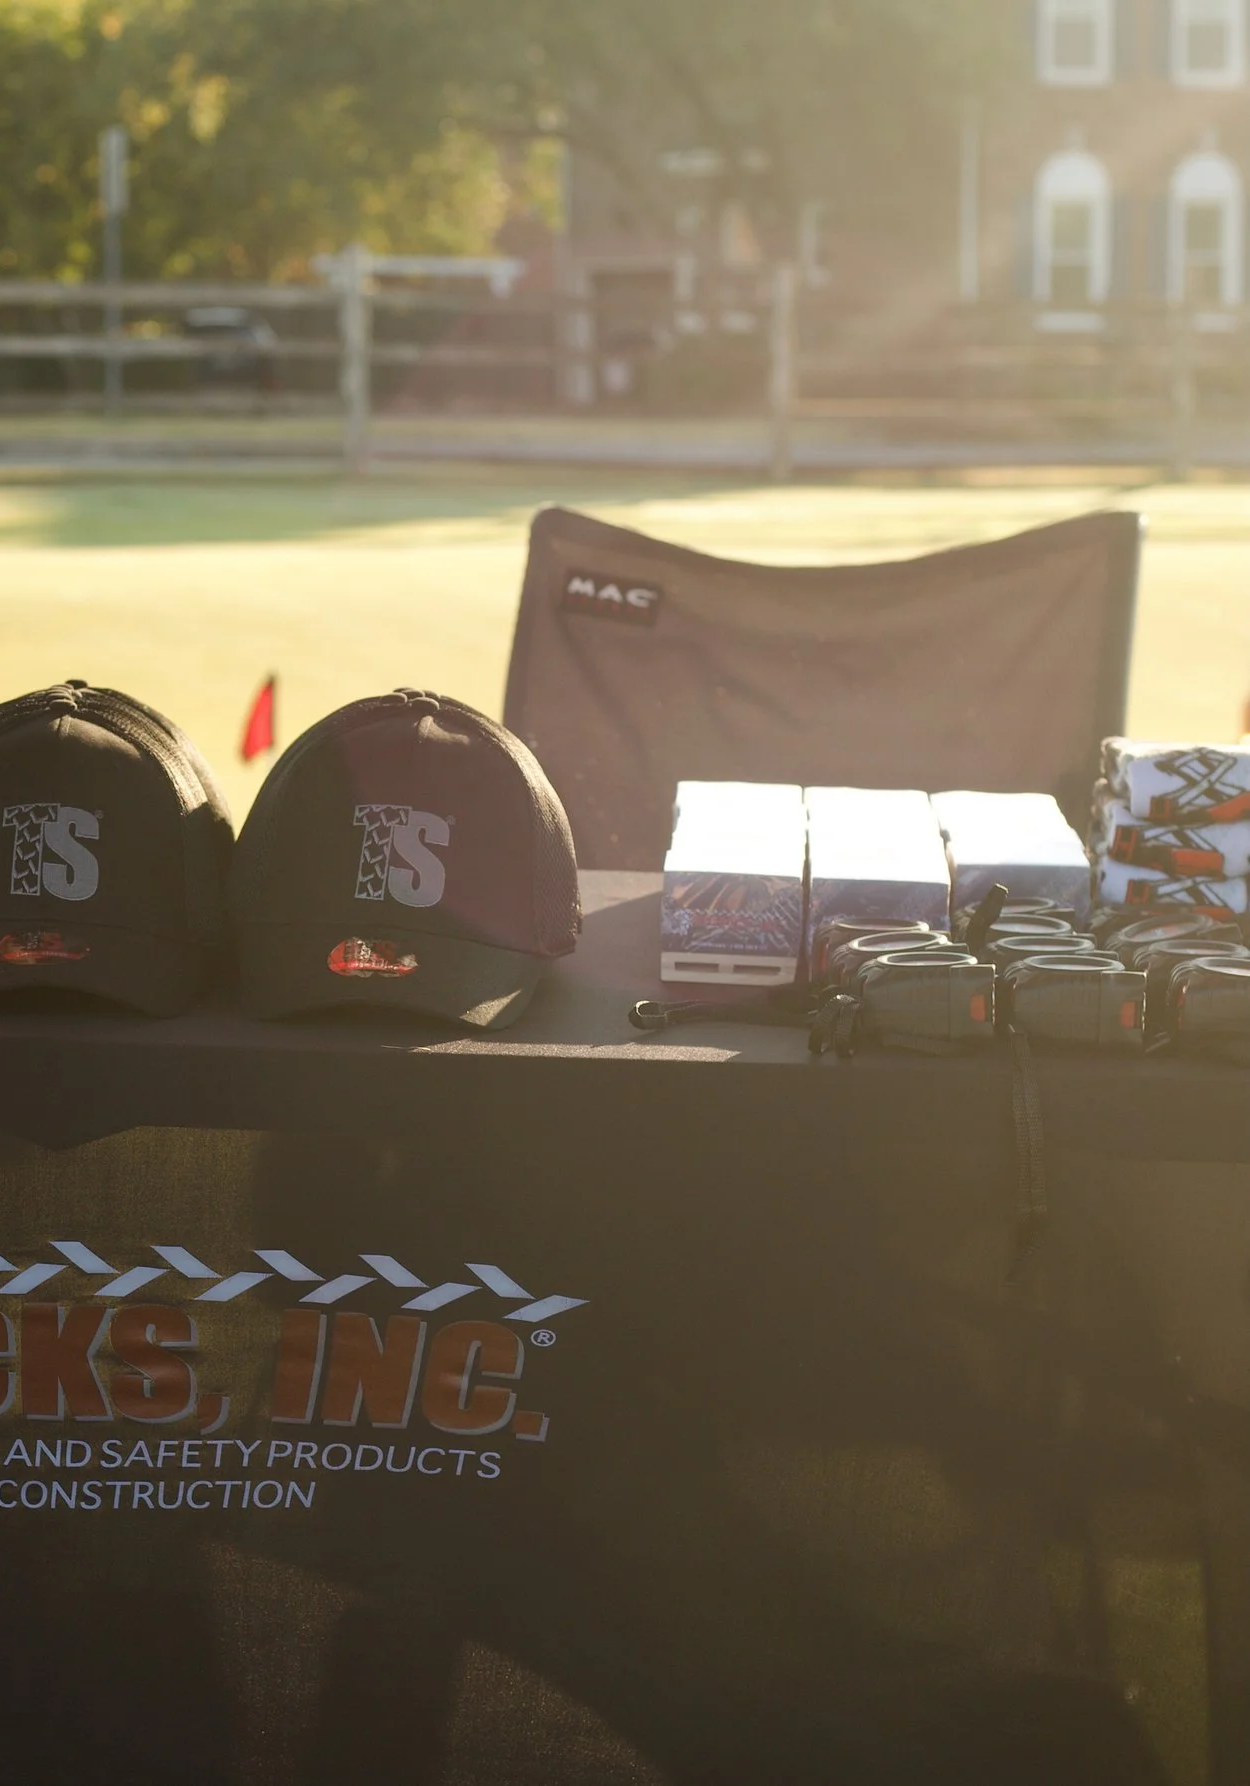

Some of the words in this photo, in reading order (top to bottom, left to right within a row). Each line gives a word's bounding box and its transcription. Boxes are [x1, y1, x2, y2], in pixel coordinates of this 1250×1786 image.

[567, 576, 659, 608] MAC
[270, 1308, 550, 1443] INC.
[3, 1439, 92, 1468] AND
[100, 1440, 262, 1468] SAFETY
[267, 1440, 503, 1480] PRODUCTS
